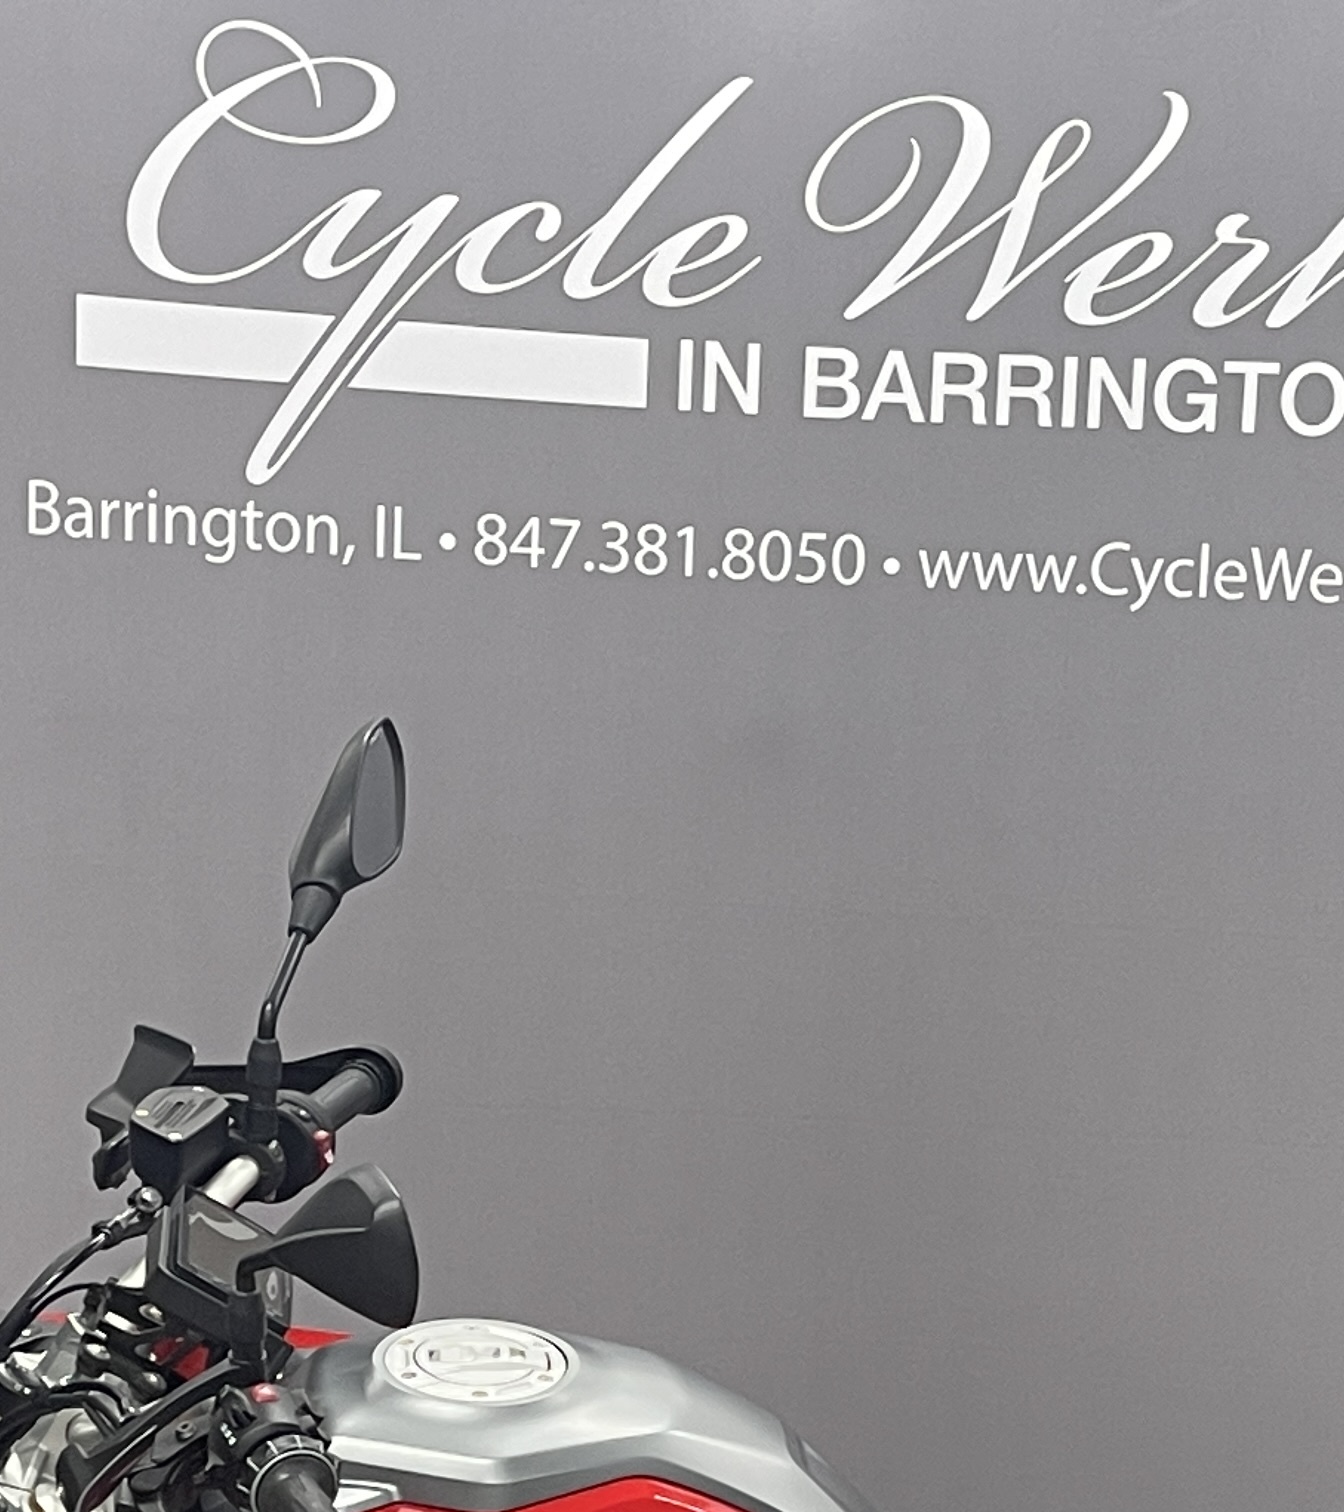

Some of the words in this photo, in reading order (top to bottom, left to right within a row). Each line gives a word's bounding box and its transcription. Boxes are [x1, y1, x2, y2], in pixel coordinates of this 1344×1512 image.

[125, 18, 762, 485] Cycle
[676, 337, 762, 415] IN
[27, 478, 356, 566] Barrington,
[375, 503, 423, 562] IL
[473, 512, 867, 587] 847.381.8050
